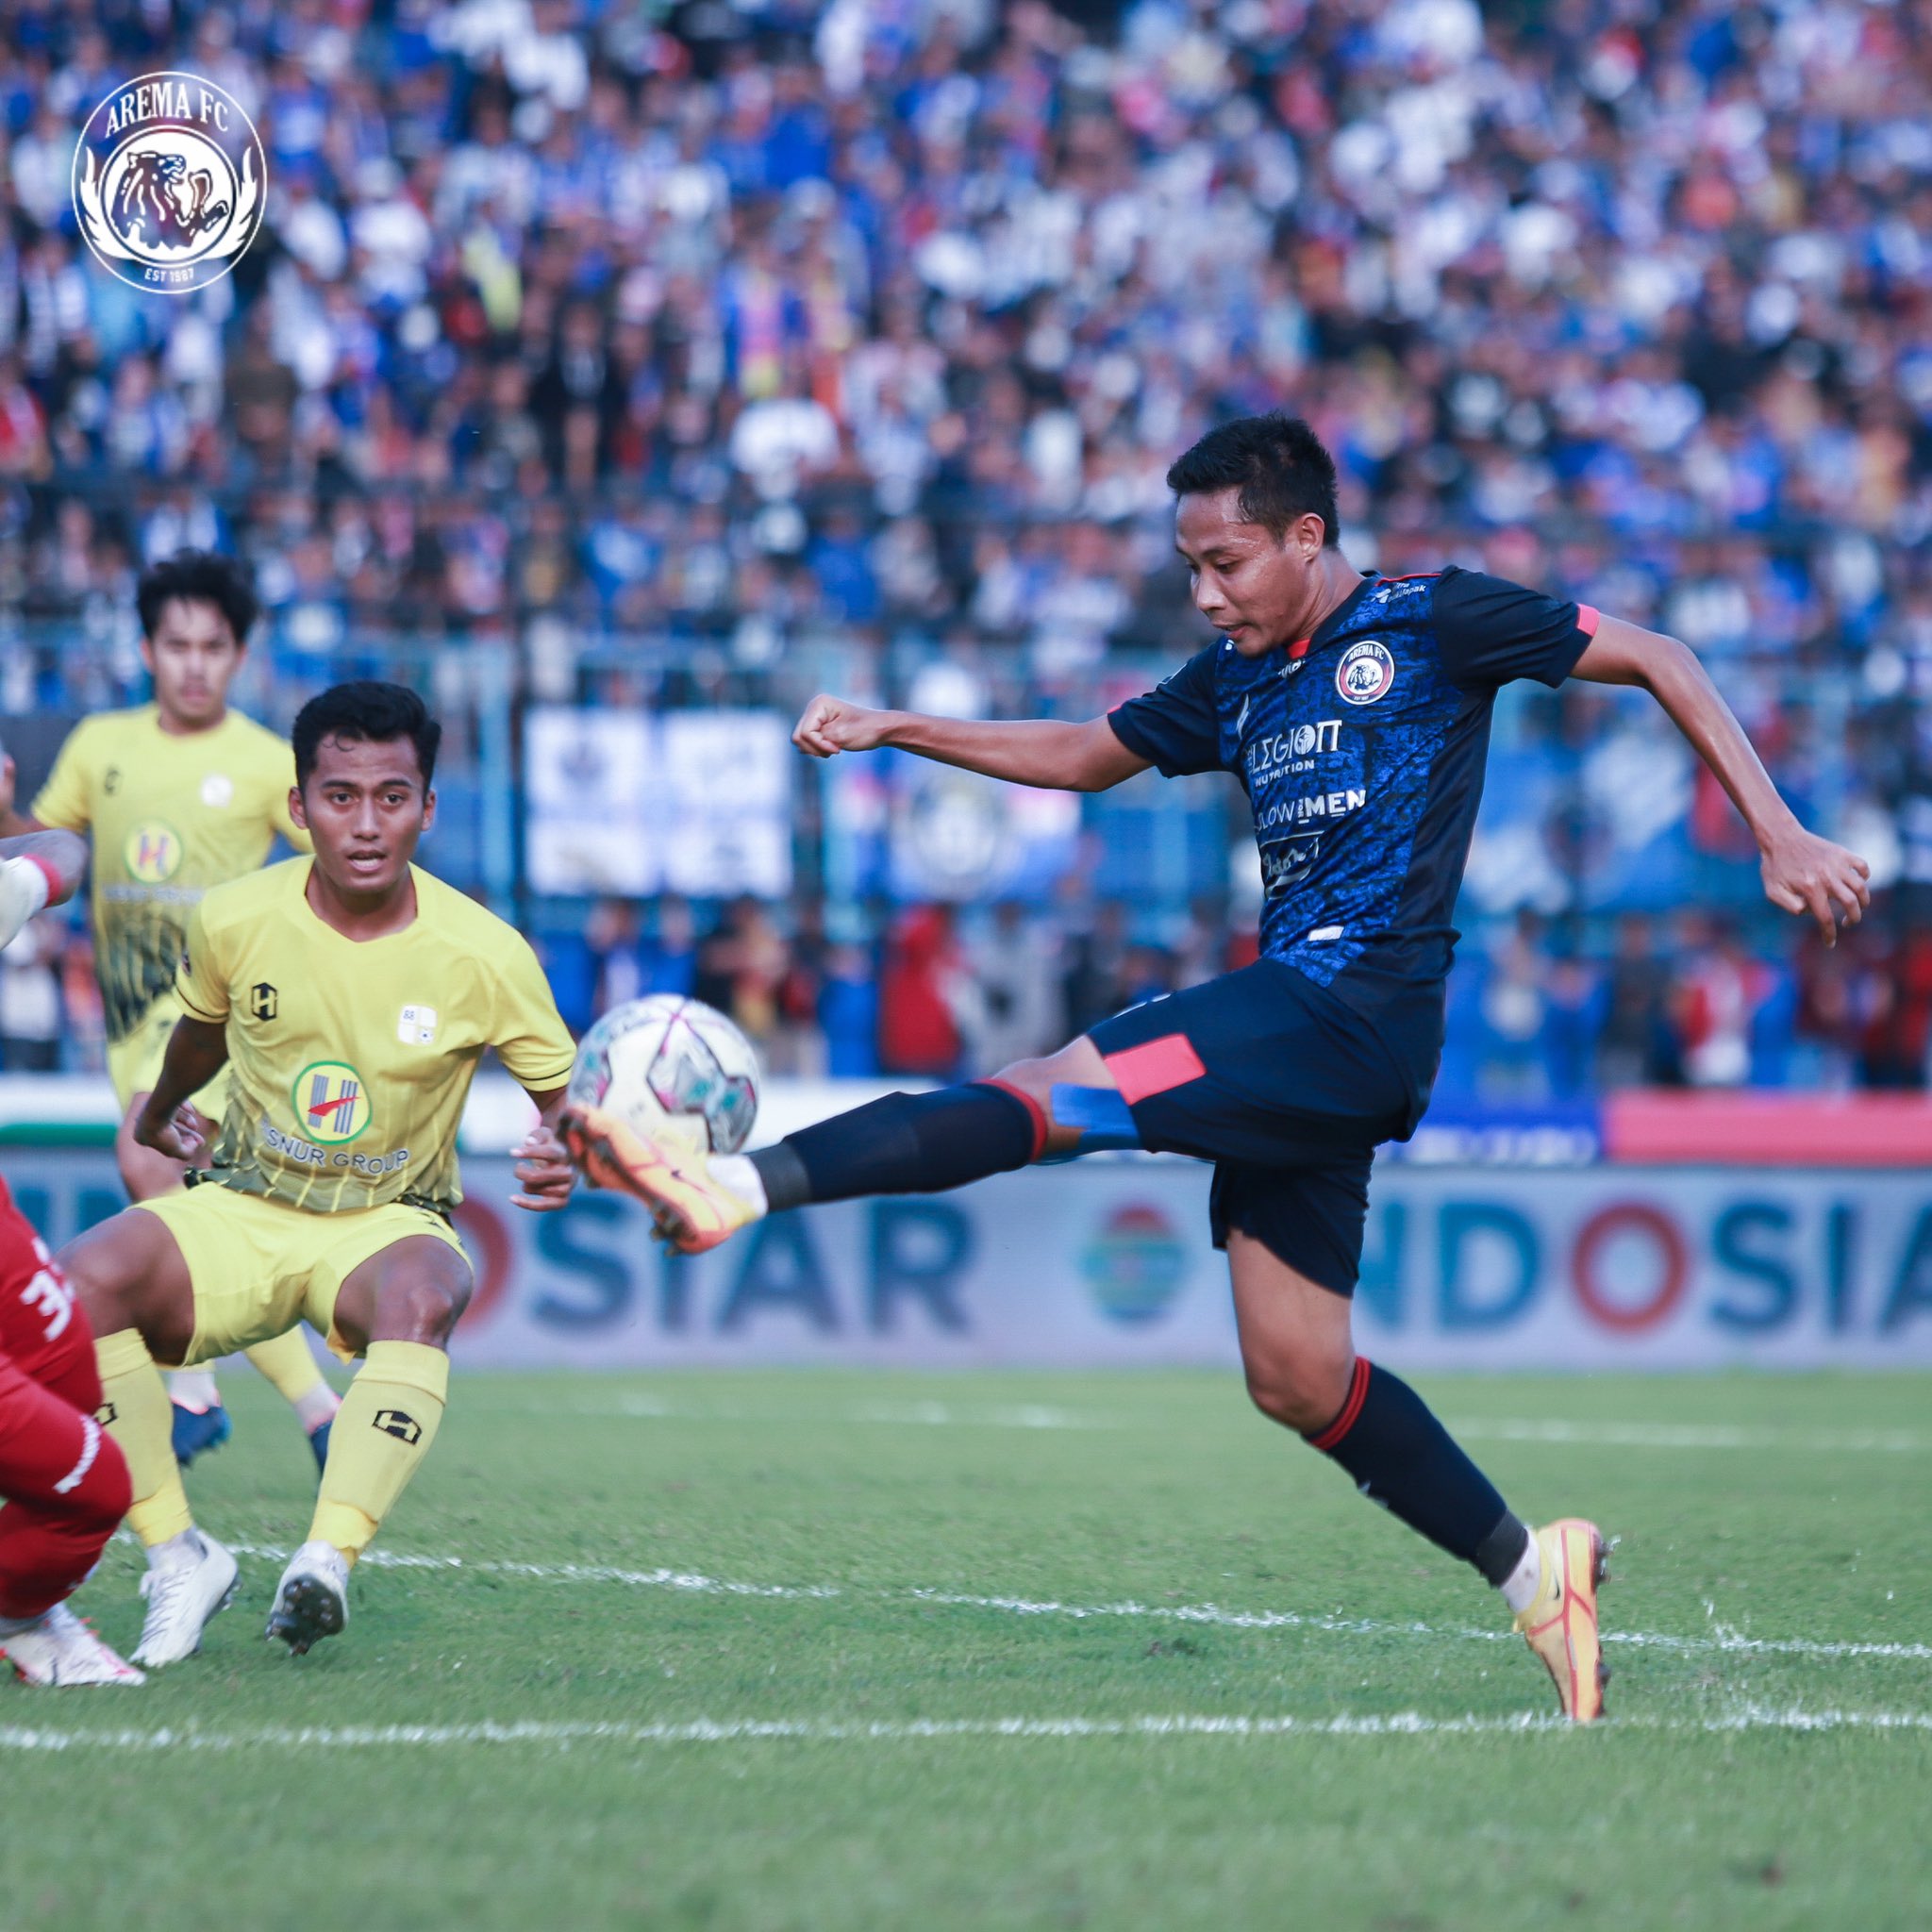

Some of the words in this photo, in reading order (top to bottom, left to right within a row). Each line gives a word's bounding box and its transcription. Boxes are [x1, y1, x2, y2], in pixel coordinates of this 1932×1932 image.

[1348, 644, 1374, 662] AREMA
[1374, 646, 1385, 660] FC
[1256, 759, 1315, 787] NUTRITION
[1305, 790, 1366, 817] MEN
[266, 1128, 325, 1167] SNUR
[332, 1148, 409, 1175] GROUP
